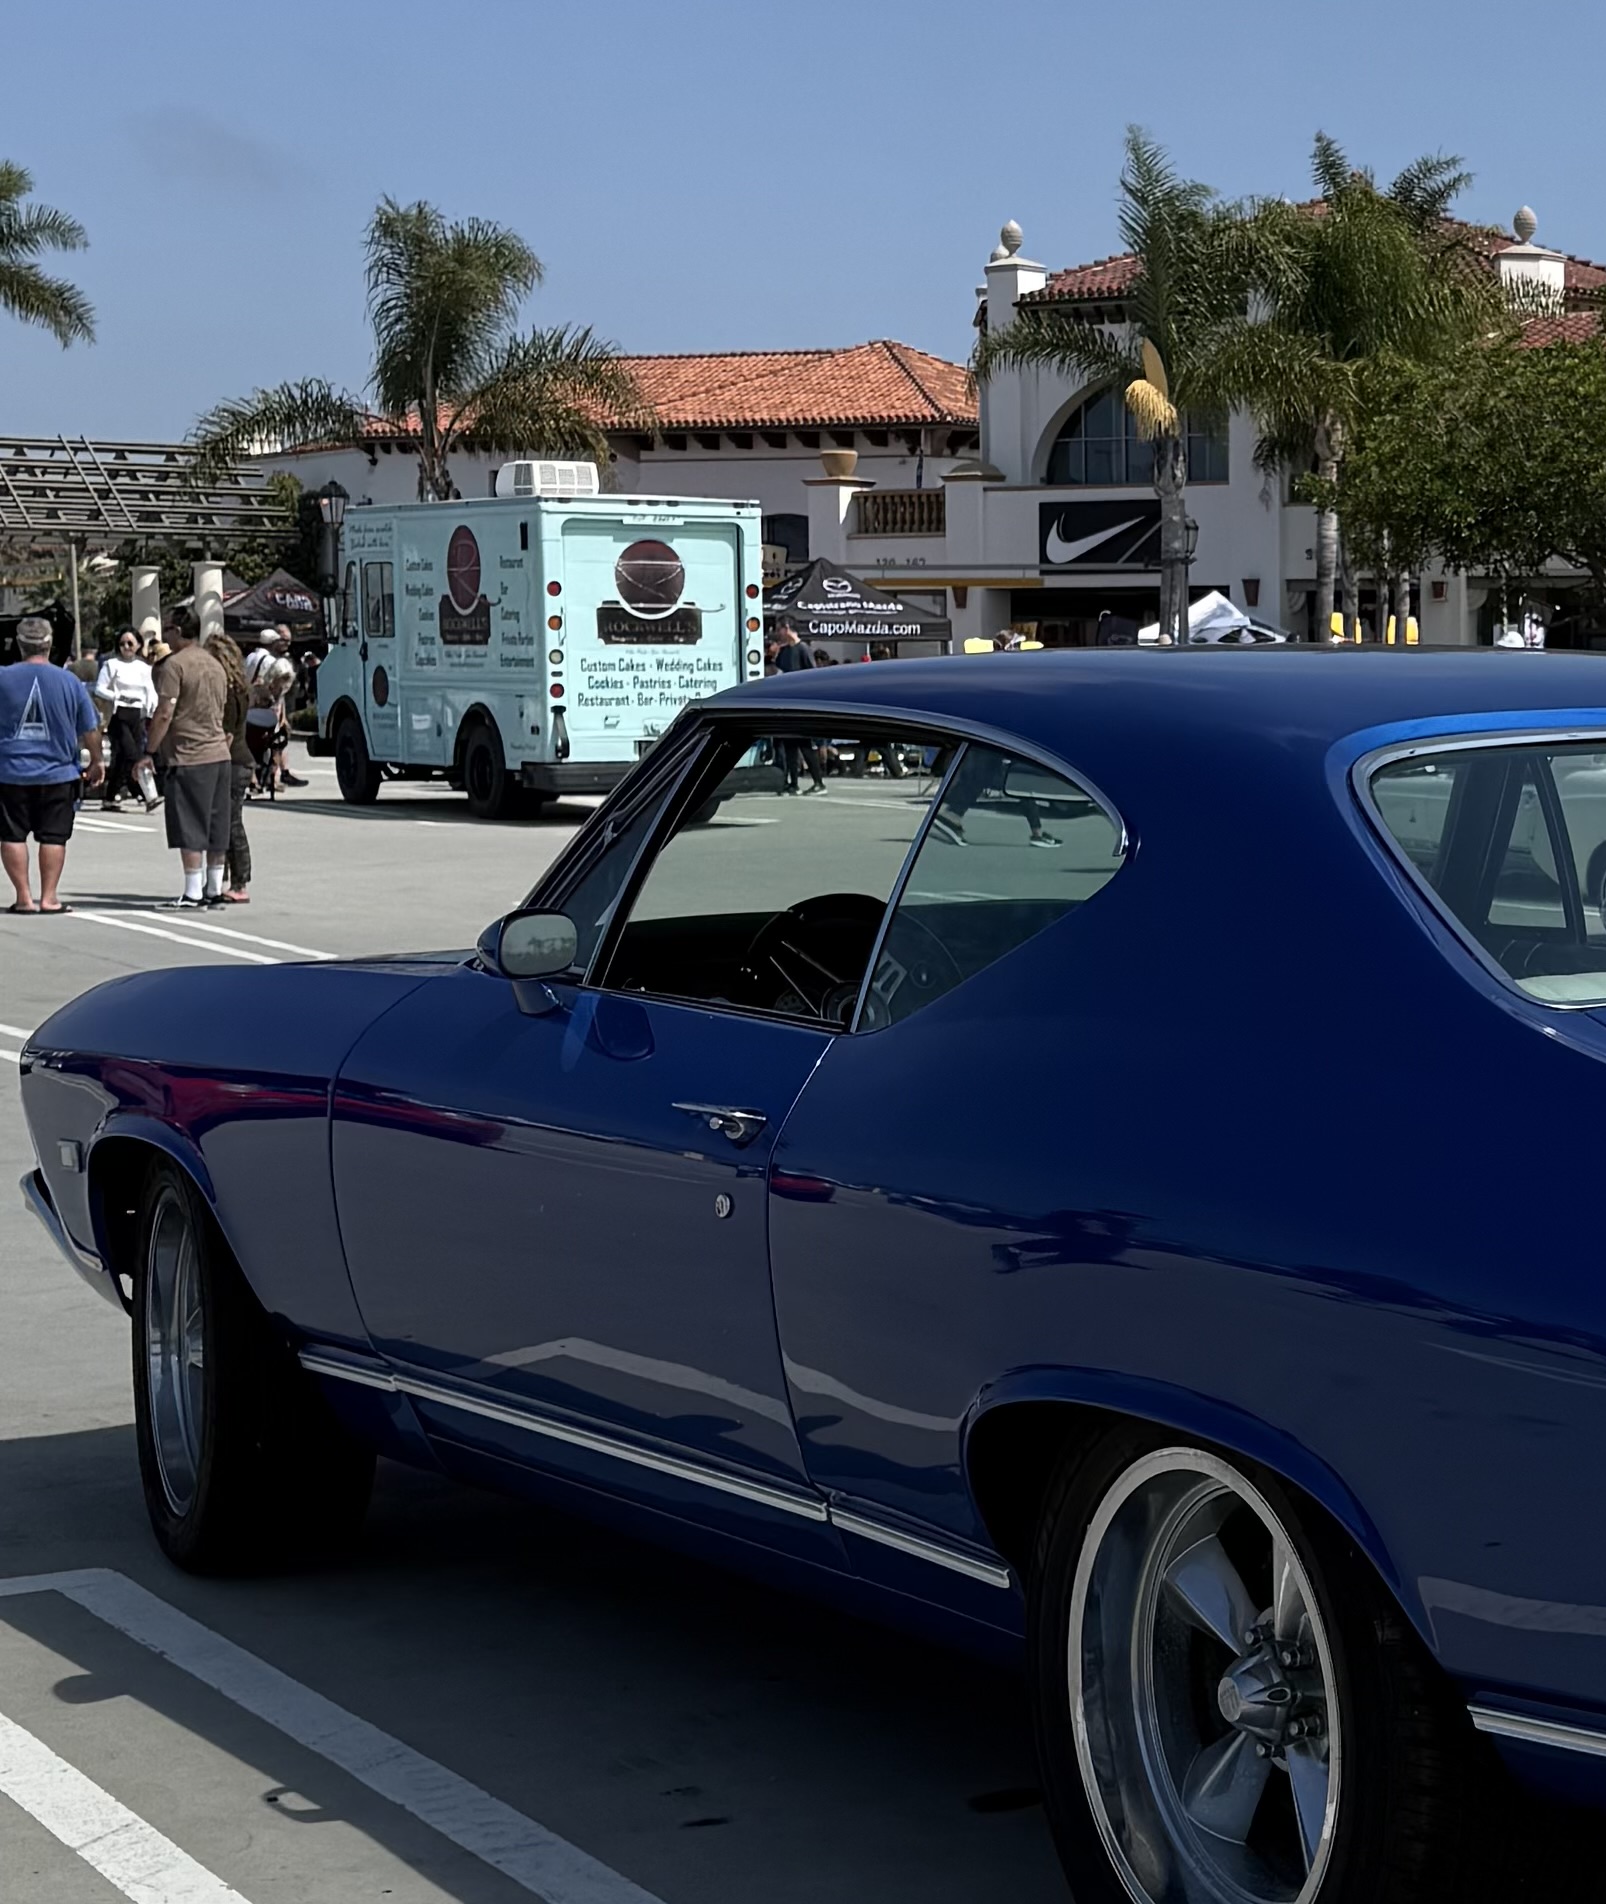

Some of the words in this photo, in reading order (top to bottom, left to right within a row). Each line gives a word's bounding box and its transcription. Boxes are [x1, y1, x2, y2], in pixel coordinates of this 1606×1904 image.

[808, 620, 921, 636] CapoMazda.com
[580, 658, 616, 672] Custom
[618, 658, 646, 672] Cakes
[655, 657, 694, 674] Wedding
[696, 658, 723, 672] Cakes
[588, 675, 624, 690] Cookies
[633, 676, 672, 689] Pastries
[678, 676, 717, 692] Catering
[578, 692, 629, 707] Restaurant
[637, 693, 654, 707] Bar
